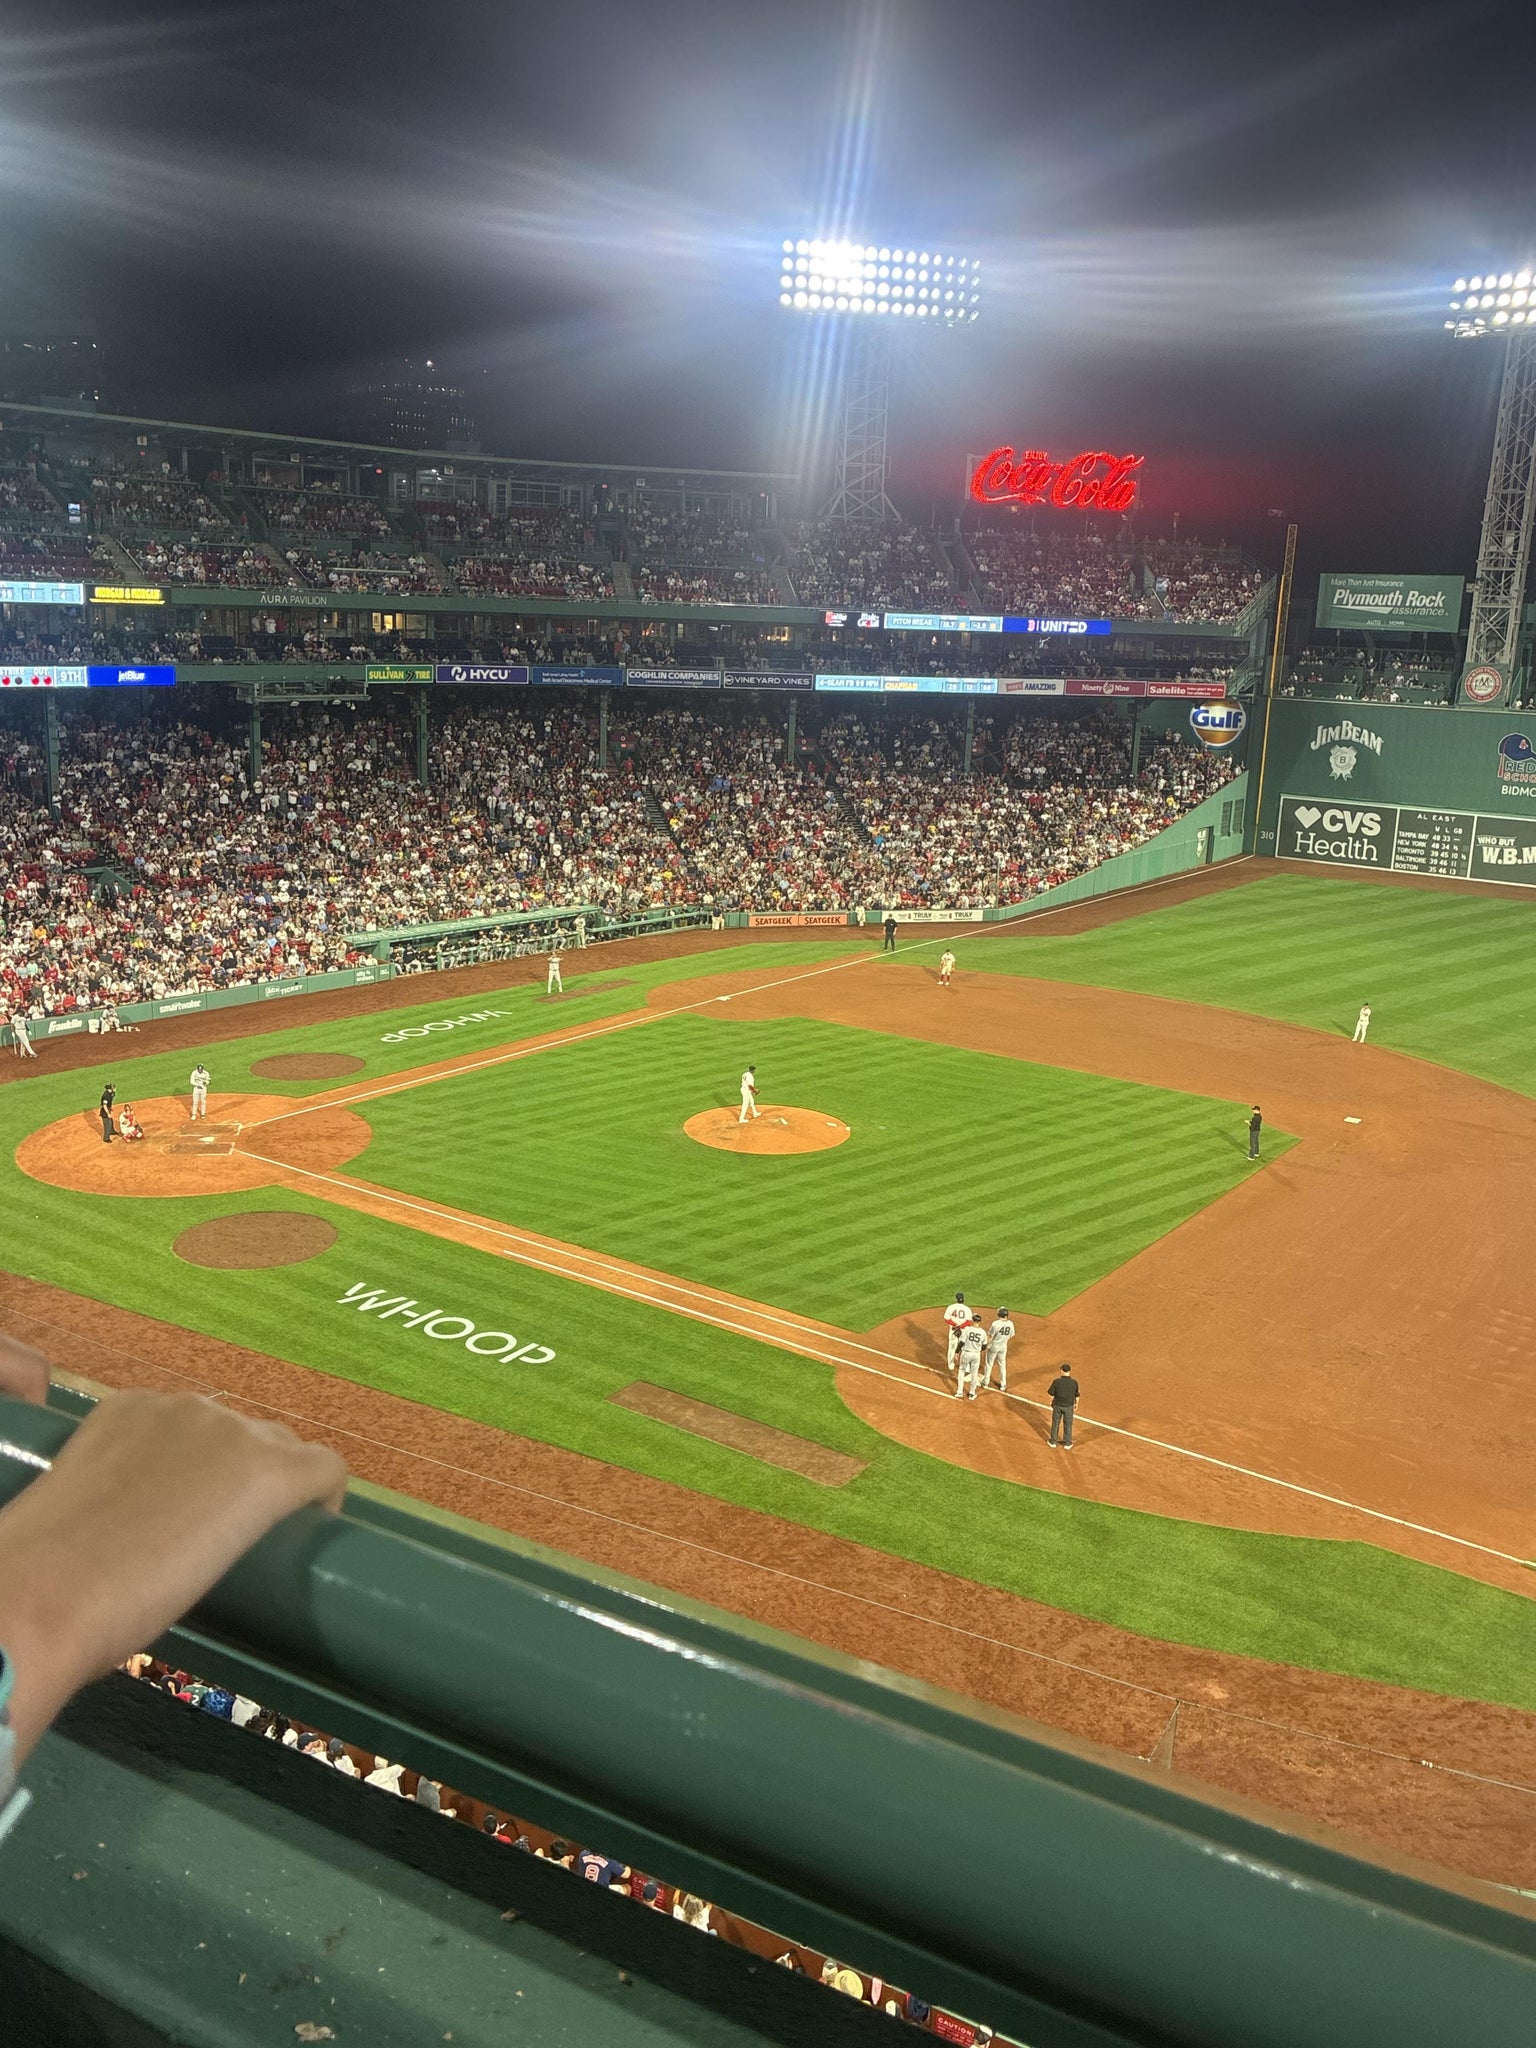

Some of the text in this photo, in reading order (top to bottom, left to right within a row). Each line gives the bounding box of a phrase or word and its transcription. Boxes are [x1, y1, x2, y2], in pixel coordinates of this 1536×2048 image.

[1025, 450, 1048, 460] ENJOY
[971, 446, 1145, 511] Coca-Cola
[1347, 578, 1362, 587] Than
[289, 595, 328, 605] PAVILION
[1332, 589, 1447, 608] Plymouth Rock
[1392, 606, 1445, 616] assurance
[892, 617, 933, 626] PITCH BREAK
[1040, 620, 1088, 633] UNITED
[33, 666, 49, 676] OUT
[118, 670, 146, 682] jetBlue
[415, 670, 431, 679] TIRE
[469, 669, 510, 680] HYCU
[629, 671, 719, 681] COGHLIN COMPANIES
[60, 671, 82, 683] 9TH
[734, 676, 810, 686] VINEYARD VINES
[865, 680, 879, 688] MPH
[884, 682, 918, 691] CHAPMAN
[1024, 682, 1057, 691] AMAZING
[1081, 684, 1103, 693] Ninety
[1149, 685, 1187, 695] Safelite
[1191, 708, 1243, 729] Gulf
[1310, 720, 1384, 756] JIM BEAM
[1504, 760, 1536, 774] RED
[1322, 808, 1382, 837] CVS
[1432, 814, 1456, 823] EAST
[1260, 830, 1275, 840] 310
[1398, 831, 1417, 839] TAMPA
[1417, 832, 1429, 840] BAY
[1294, 831, 1379, 861] Health
[1411, 840, 1427, 848] YORK
[1477, 837, 1516, 846] WHO BUT
[1397, 847, 1425, 855] TORONTO
[1395, 854, 1427, 864] BALTIMORE
[1394, 862, 1419, 871] BOSTON
[754, 916, 792, 926] SEATGEEK
[804, 915, 841, 925] SEATGEEK
[280, 984, 303, 995] TICKET
[159, 1000, 202, 1014] smartwater
[380, 1009, 513, 1043] WHOOP
[951, 1309, 965, 1319] 40
[335, 1281, 557, 1365] WHOOP
[998, 1326, 1011, 1336] 48
[968, 1331, 982, 1343] 85
[937, 2017, 975, 2037] CAUTION!
